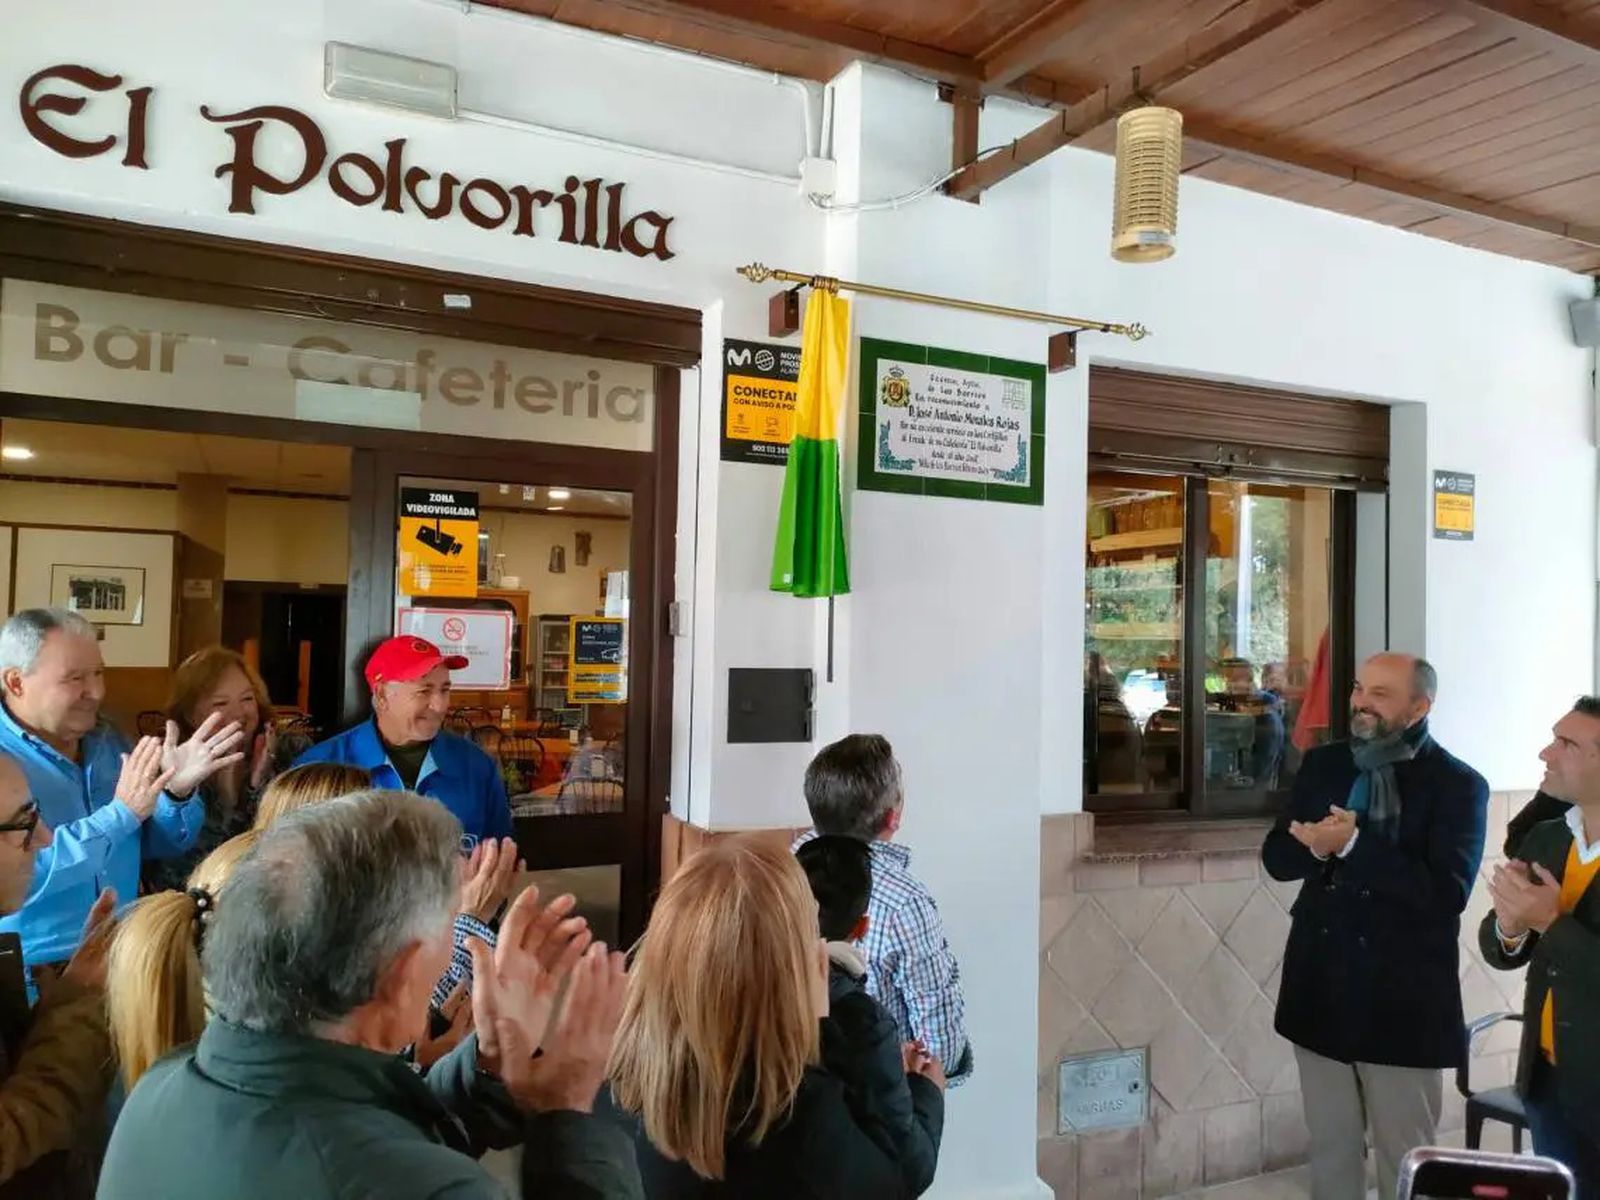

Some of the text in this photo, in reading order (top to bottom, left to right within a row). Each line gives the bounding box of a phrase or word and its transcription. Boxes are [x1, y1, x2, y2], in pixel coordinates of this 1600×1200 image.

[20, 63, 677, 262] El Polvorilla
[34, 303, 188, 374] Bar
[287, 334, 646, 424] Cafeteria
[996, 416, 1020, 430] Rojas
[429, 493, 455, 503] ZONA
[406, 503, 476, 516] VIDEOVIGILADA
